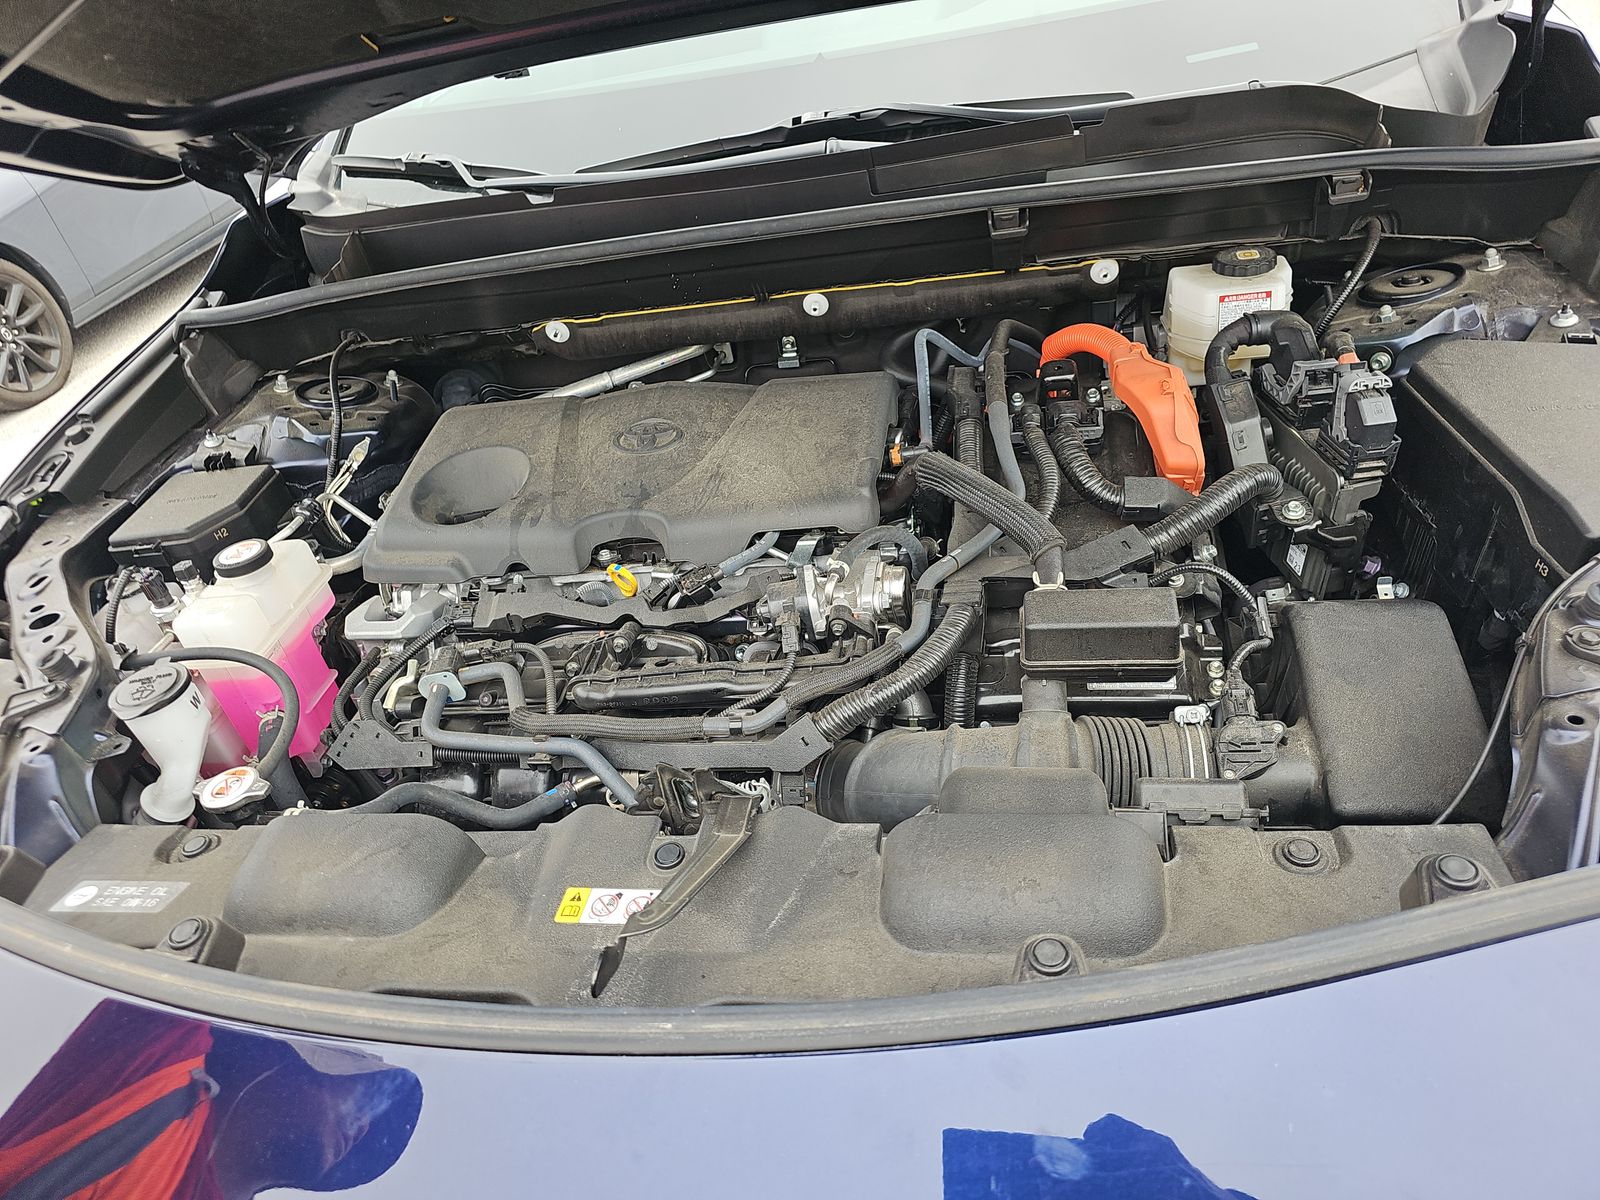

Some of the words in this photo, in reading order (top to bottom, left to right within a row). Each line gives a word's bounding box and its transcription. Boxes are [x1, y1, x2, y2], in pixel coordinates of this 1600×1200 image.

[213, 527, 229, 541] H2
[1535, 558, 1549, 577] H3
[190, 691, 202, 710] W
[104, 886, 149, 896] ENGINE
